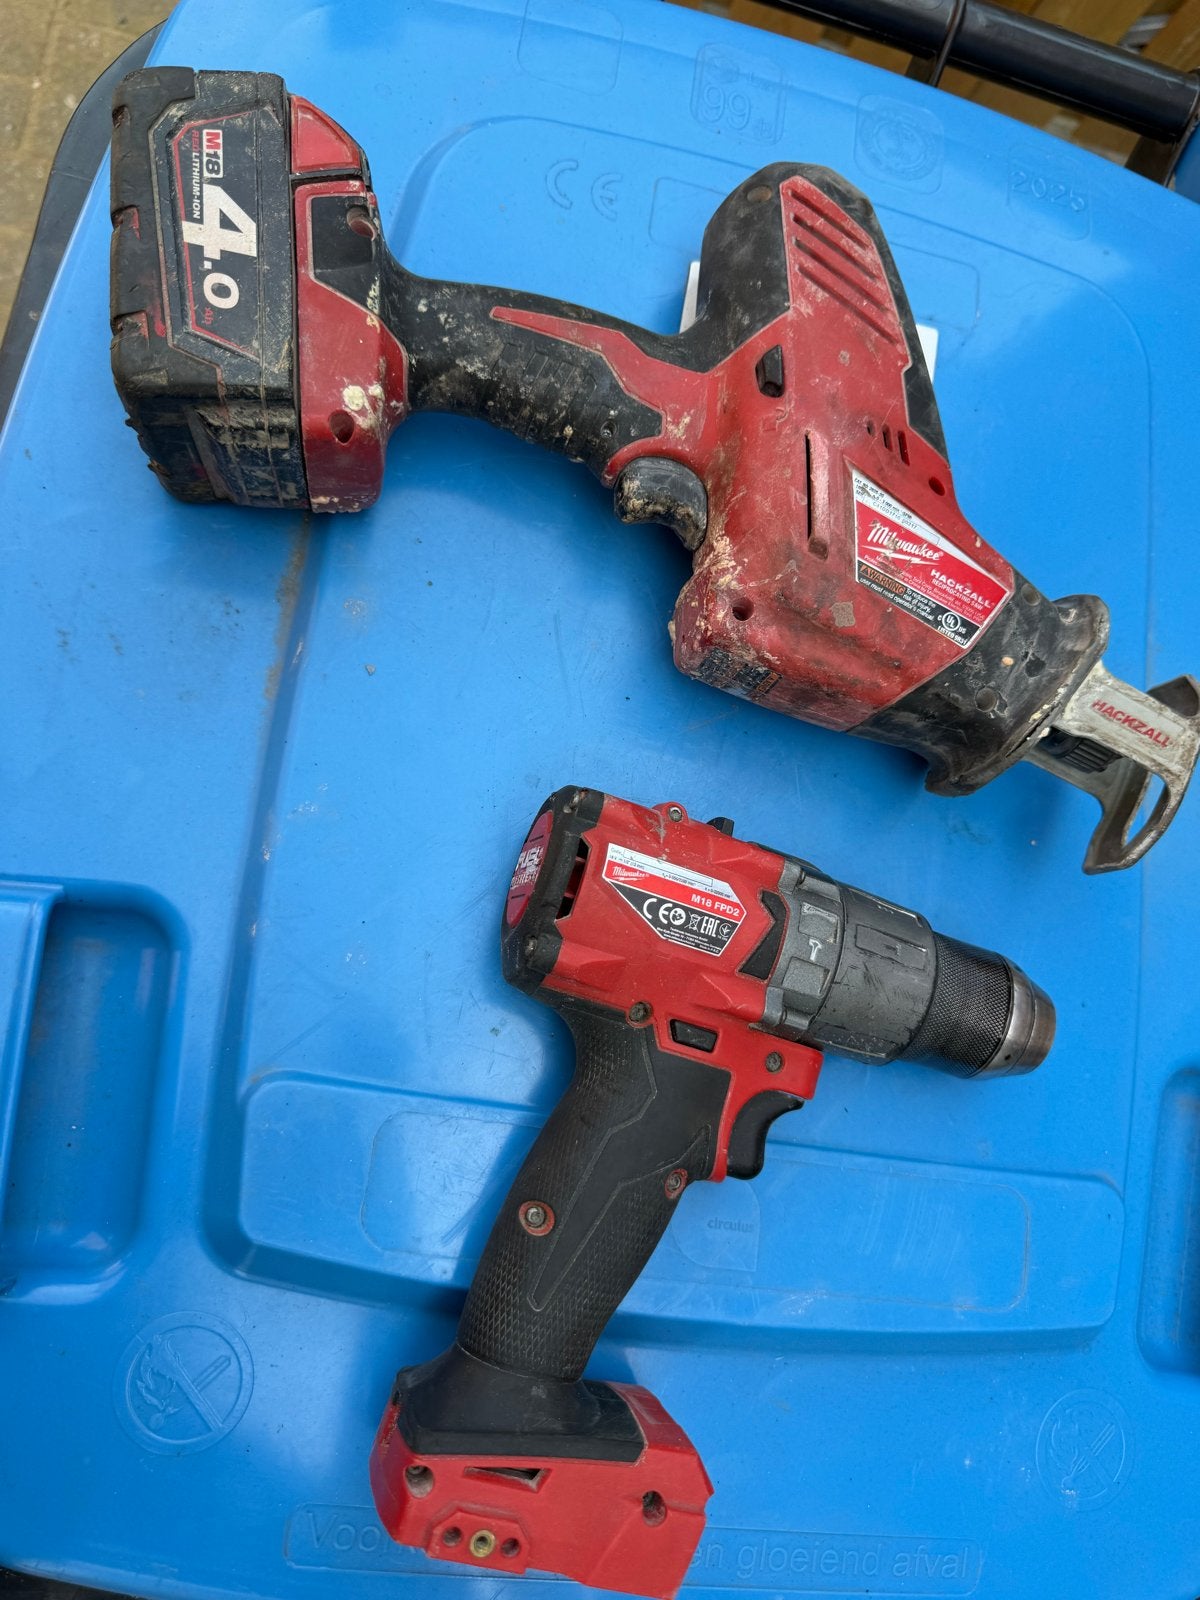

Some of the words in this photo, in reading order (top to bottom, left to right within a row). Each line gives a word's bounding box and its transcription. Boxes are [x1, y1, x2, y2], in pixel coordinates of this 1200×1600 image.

[702, 83, 750, 130] 99
[205, 131, 221, 177] M18
[1010, 169, 1086, 213] 2025
[183, 184, 257, 310] 4.0
[867, 520, 940, 560] Milwaukee
[867, 569, 905, 594] WARNING
[930, 569, 991, 608] HACKZALL
[1090, 698, 1169, 747] HACKZALL
[691, 893, 712, 908] M18
[714, 901, 740, 916] FPD2
[736, 1538, 884, 1580] gloeiend
[894, 1545, 969, 1580] afval
